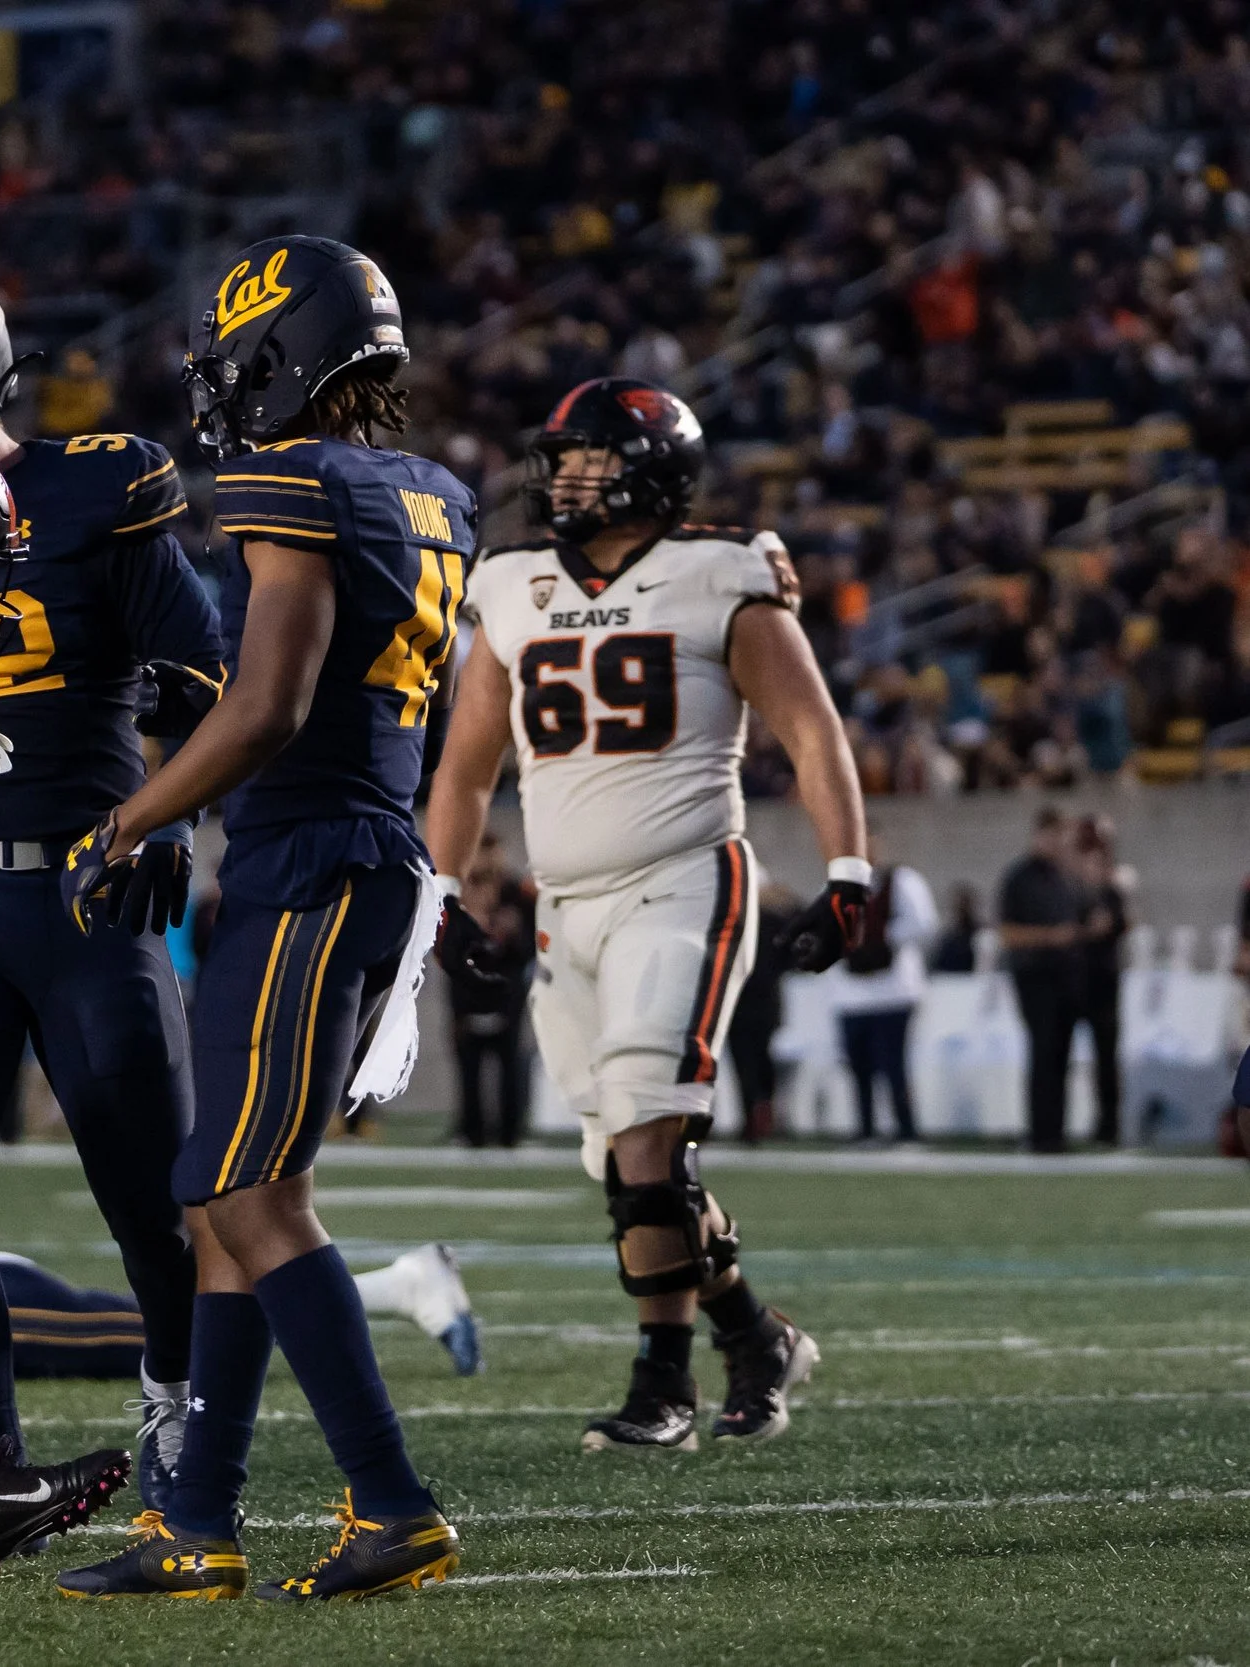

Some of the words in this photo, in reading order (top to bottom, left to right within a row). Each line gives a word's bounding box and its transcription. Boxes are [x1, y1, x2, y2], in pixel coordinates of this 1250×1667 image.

[216, 248, 292, 341] Cal
[400, 489, 452, 543] YOUNG
[362, 549, 464, 727] 41
[549, 607, 631, 630] BEAVS
[519, 632, 678, 760] 69
